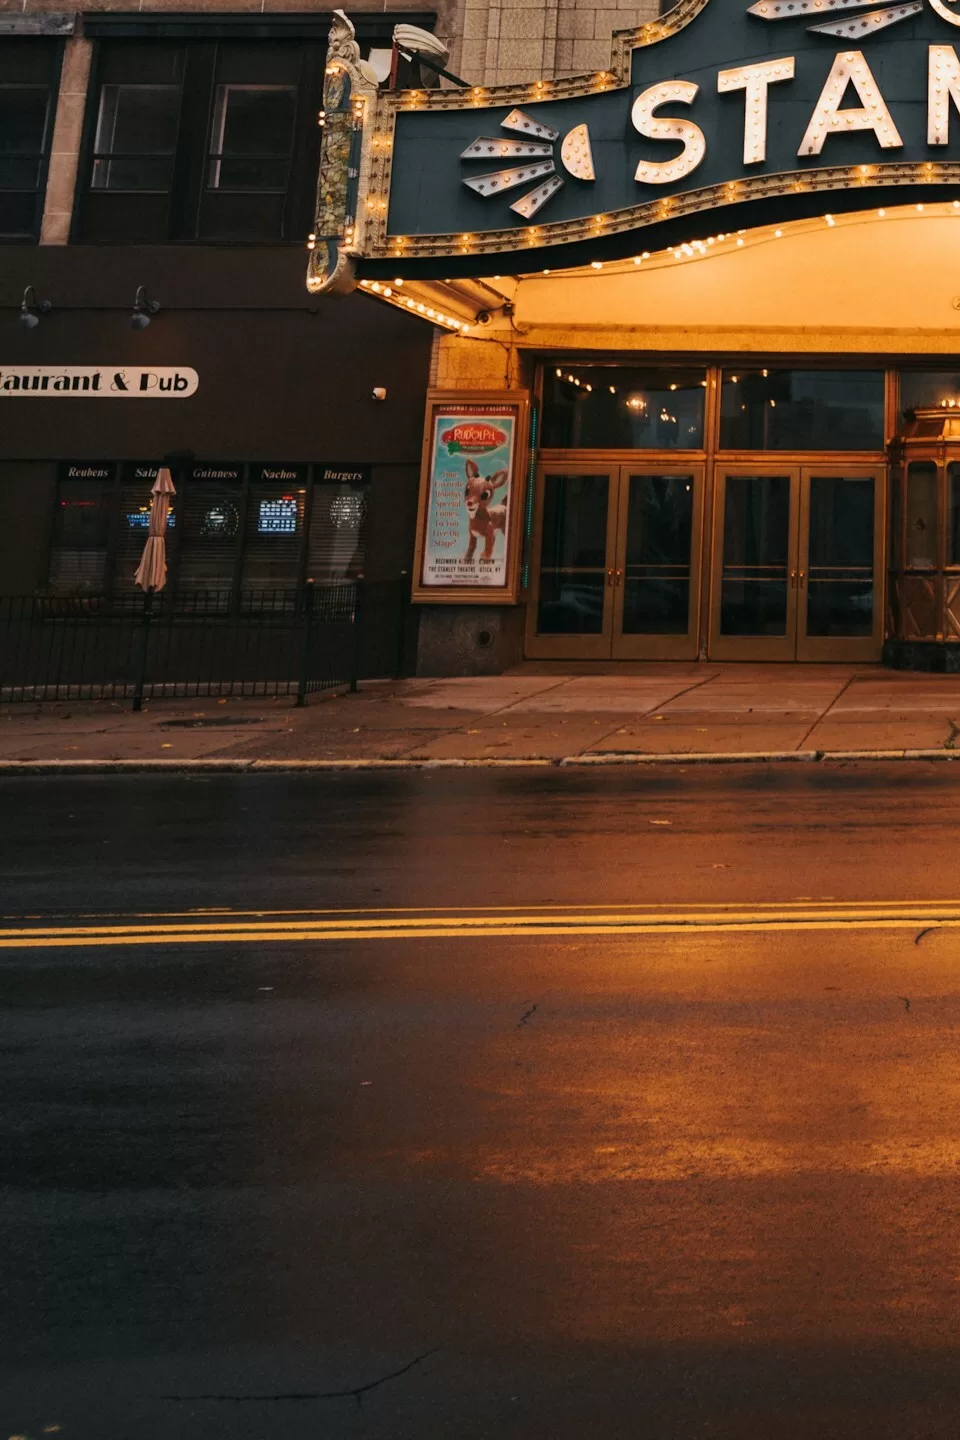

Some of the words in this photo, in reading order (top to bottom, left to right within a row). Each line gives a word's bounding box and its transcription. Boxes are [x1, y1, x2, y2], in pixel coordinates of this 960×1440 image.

[110, 372, 131, 392] &
[139, 373, 189, 392] Pub
[453, 428, 495, 440] RUDOLPH
[68, 467, 109, 478] Reubens
[135, 467, 158, 478] Sala
[193, 468, 239, 479] Guinness
[261, 469, 298, 480] Nachos
[323, 470, 364, 481] Burgers
